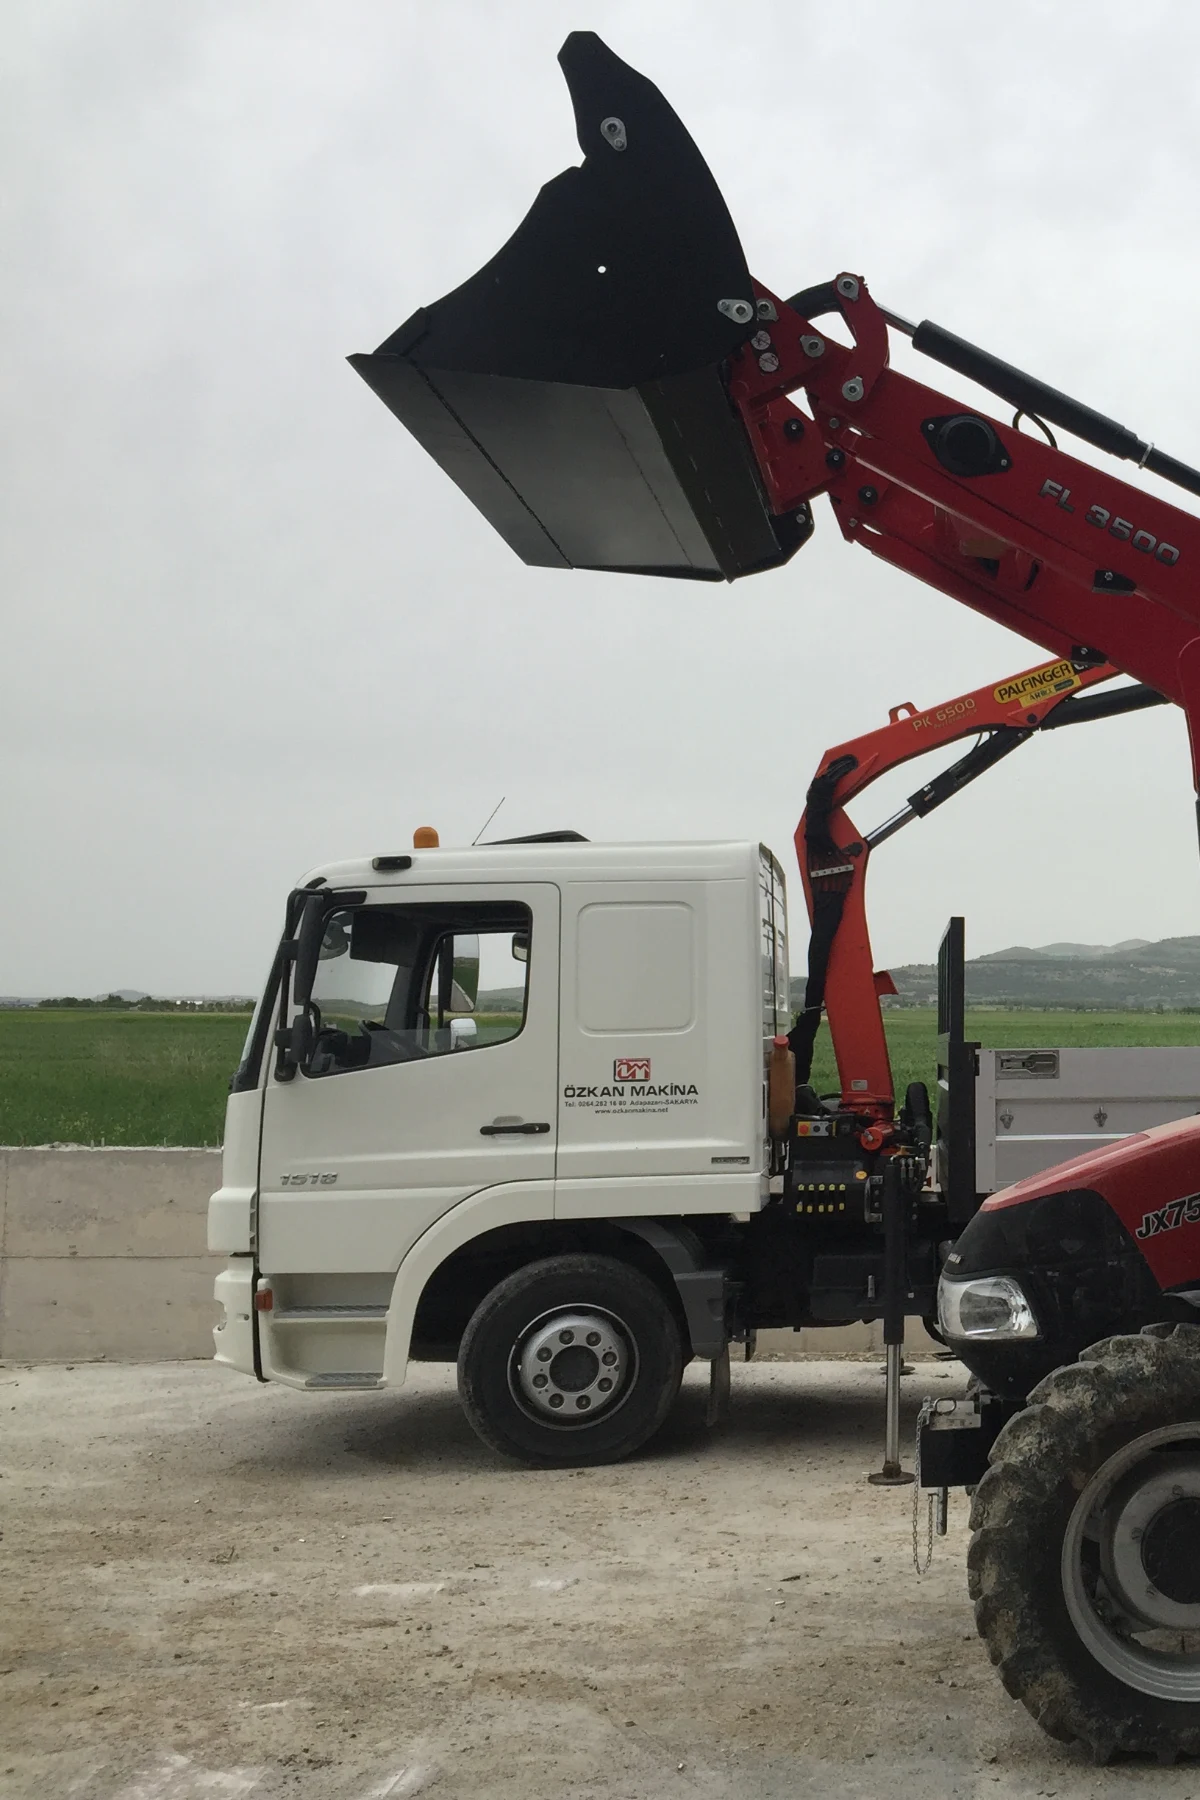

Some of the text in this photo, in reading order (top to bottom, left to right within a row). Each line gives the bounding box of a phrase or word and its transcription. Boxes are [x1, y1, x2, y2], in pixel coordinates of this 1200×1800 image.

[1038, 478, 1180, 567] FL 3500
[997, 662, 1073, 702] PALFINGER
[912, 698, 976, 731] PK 6500
[564, 1082, 699, 1098] ÖZKAN MAKİNA
[280, 1172, 338, 1186] 1518
